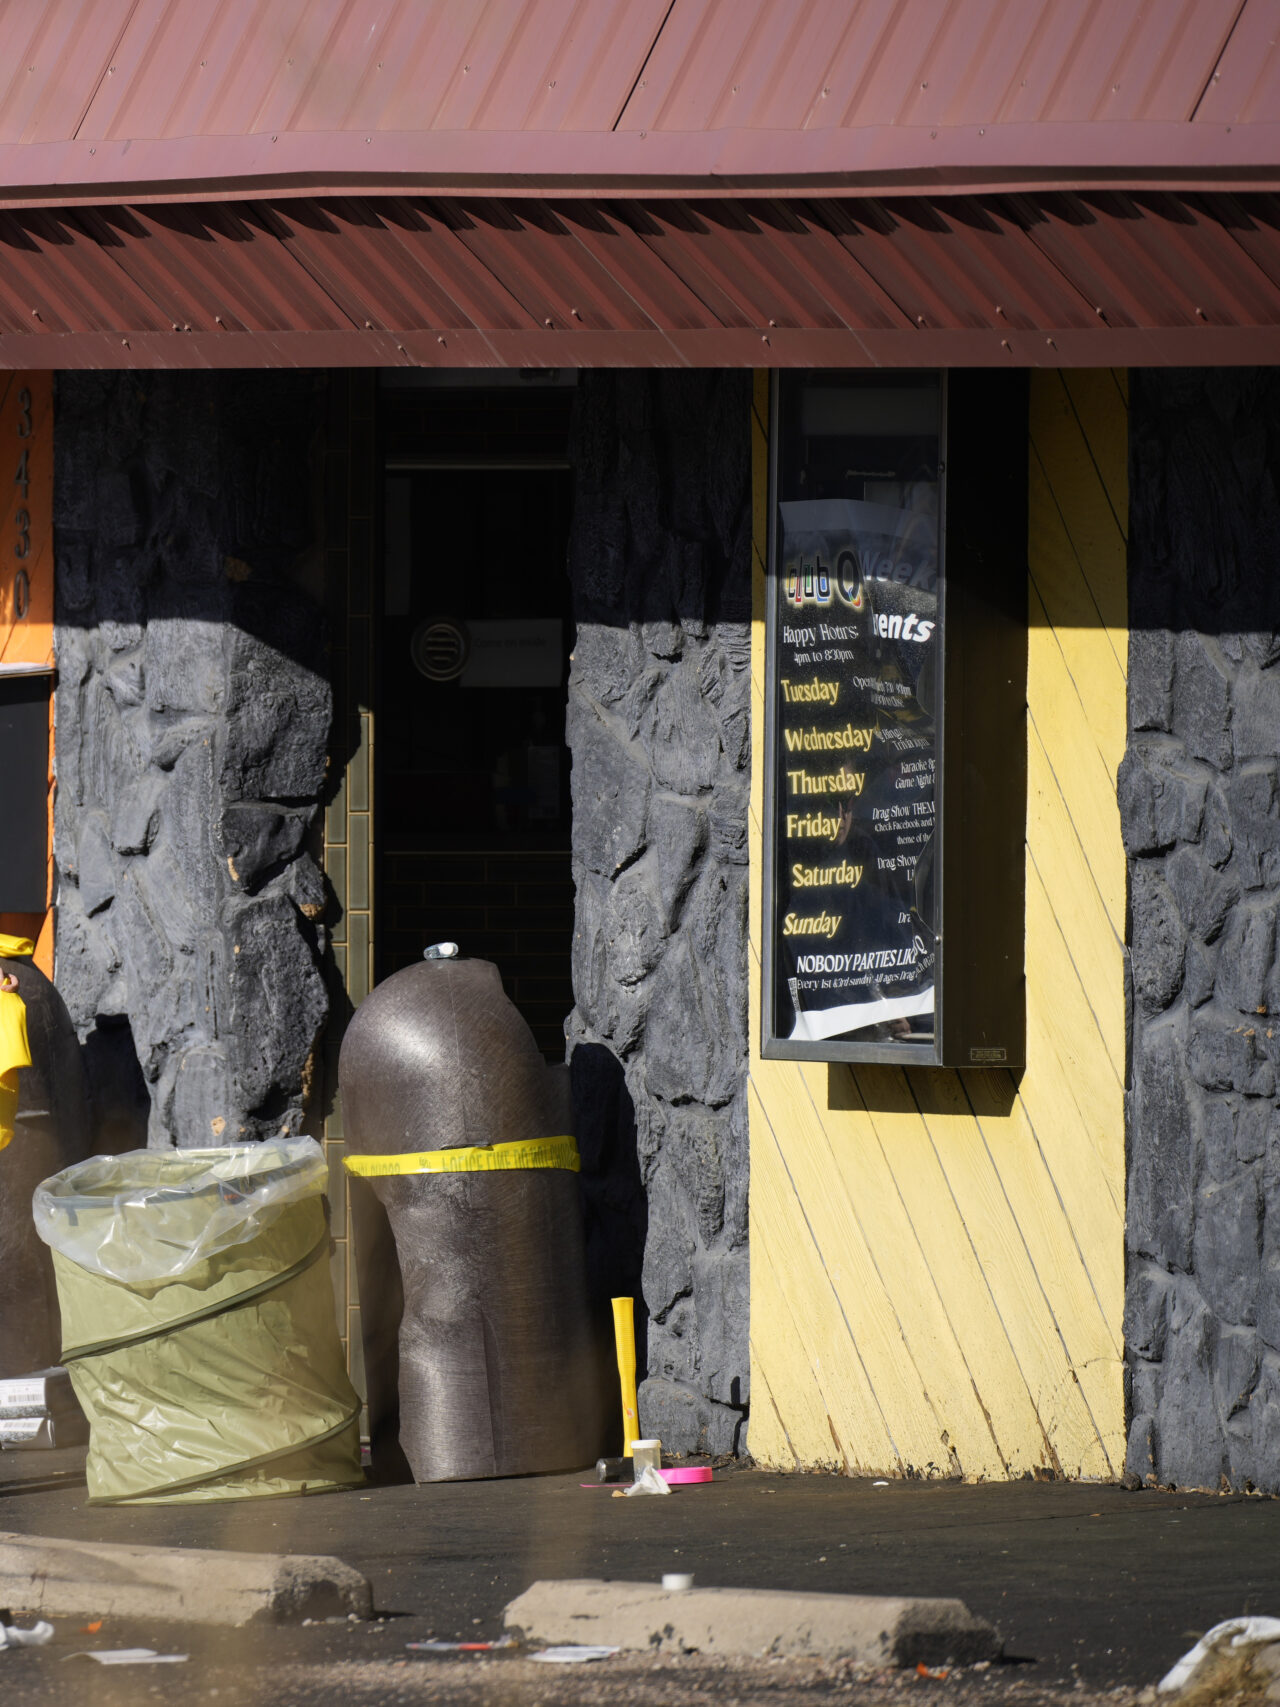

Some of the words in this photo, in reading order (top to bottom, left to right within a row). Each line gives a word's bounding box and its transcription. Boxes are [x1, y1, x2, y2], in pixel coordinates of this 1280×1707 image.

[783, 625, 816, 647] Happy
[812, 652, 822, 662] to
[781, 676, 840, 705] Tuesday
[784, 723, 873, 752] Wednesday
[900, 759, 927, 774] Karaoke
[787, 768, 865, 796] Thursday
[895, 777, 914, 789] Game
[872, 807, 890, 822] Drag
[891, 804, 910, 818] Show
[921, 816, 933, 828] and
[786, 812, 842, 841] Friday
[896, 834, 915, 845] theme
[877, 857, 896, 871] Drag
[897, 854, 918, 866] Show
[792, 859, 863, 888] Saturday
[783, 910, 842, 938] Sunday
[797, 954, 853, 973] NOBODY
[852, 949, 897, 971] PARTIES
[797, 979, 818, 991] Every
